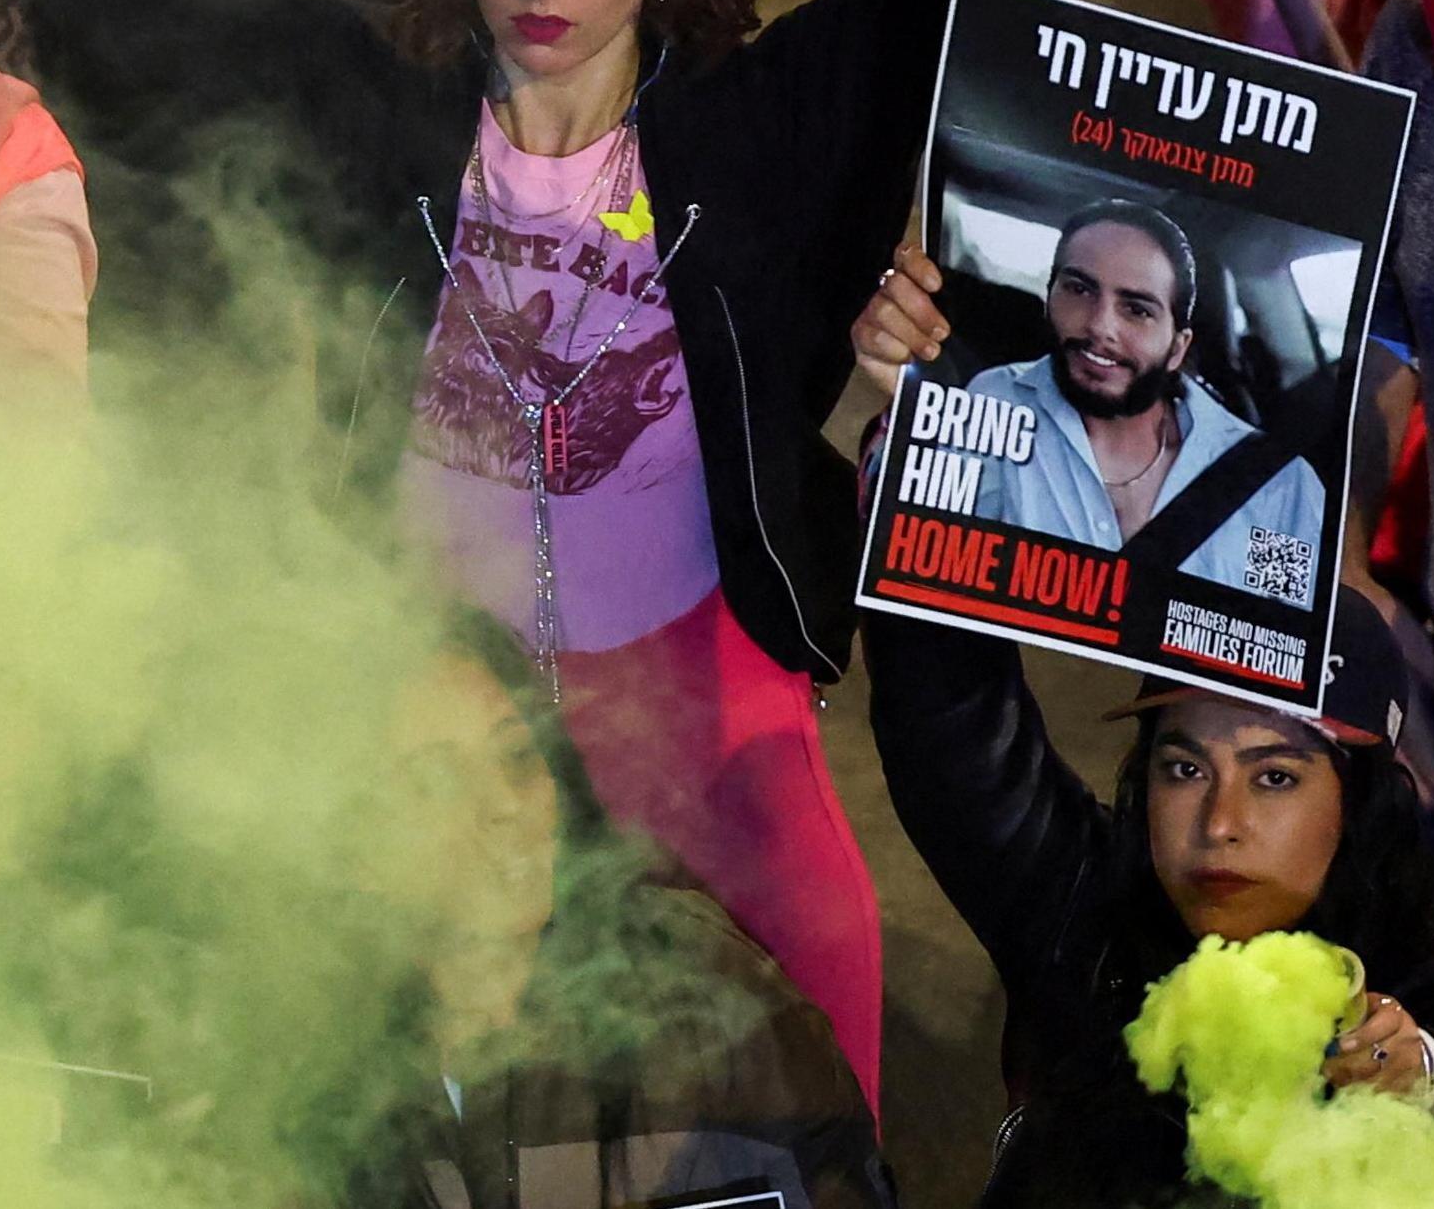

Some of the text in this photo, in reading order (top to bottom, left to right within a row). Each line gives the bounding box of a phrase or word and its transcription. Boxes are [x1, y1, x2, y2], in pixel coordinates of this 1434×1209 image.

[1038, 25, 1318, 154] מתן עדיין חי
[1071, 110, 1256, 188] מתן צנגאוקר (24)
[459, 218, 673, 310] BITE BAC
[911, 380, 1037, 463] BRING
[897, 444, 982, 516] HIM
[886, 513, 1129, 622] HOME NOW!
[1163, 619, 1241, 665] FAMILIES
[1242, 642, 1305, 684] FORUM
[1167, 599, 1306, 657] HOSTAGES AND MISSING
